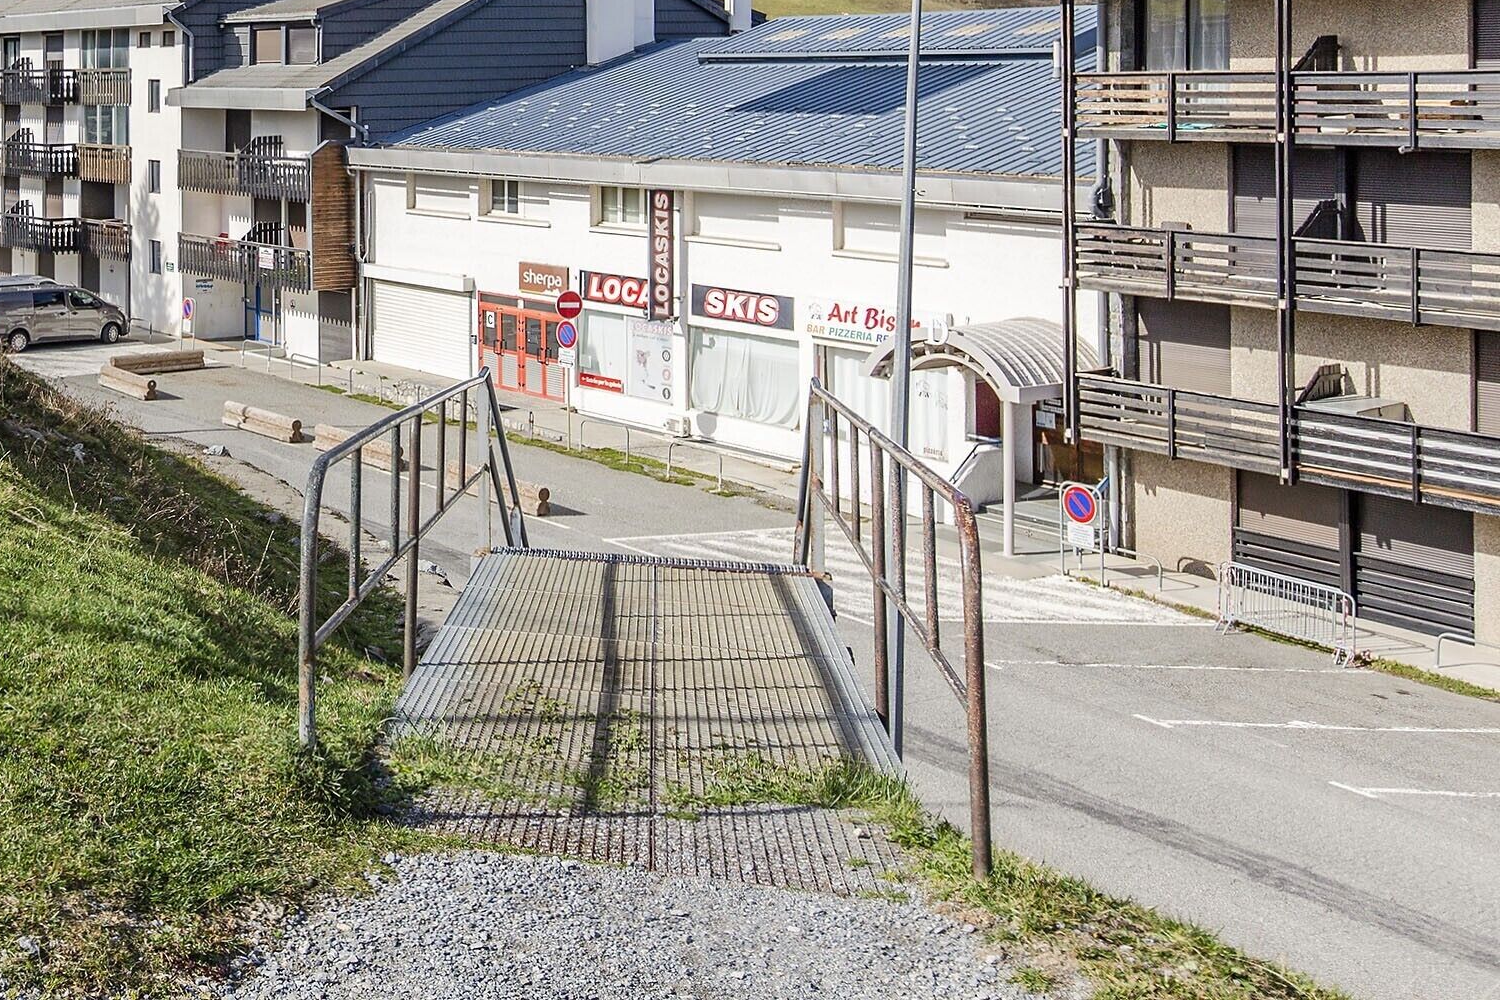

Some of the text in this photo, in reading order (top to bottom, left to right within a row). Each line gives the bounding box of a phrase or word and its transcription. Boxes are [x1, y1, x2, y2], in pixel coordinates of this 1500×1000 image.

[654, 192, 670, 316] LOCASKIS
[522, 268, 563, 289] sherpa
[705, 289, 779, 325] SKIS
[827, 302, 858, 324] Art
[487, 314, 493, 325] C
[806, 323, 825, 335] BAR
[829, 326, 872, 342] PIZZERIA
